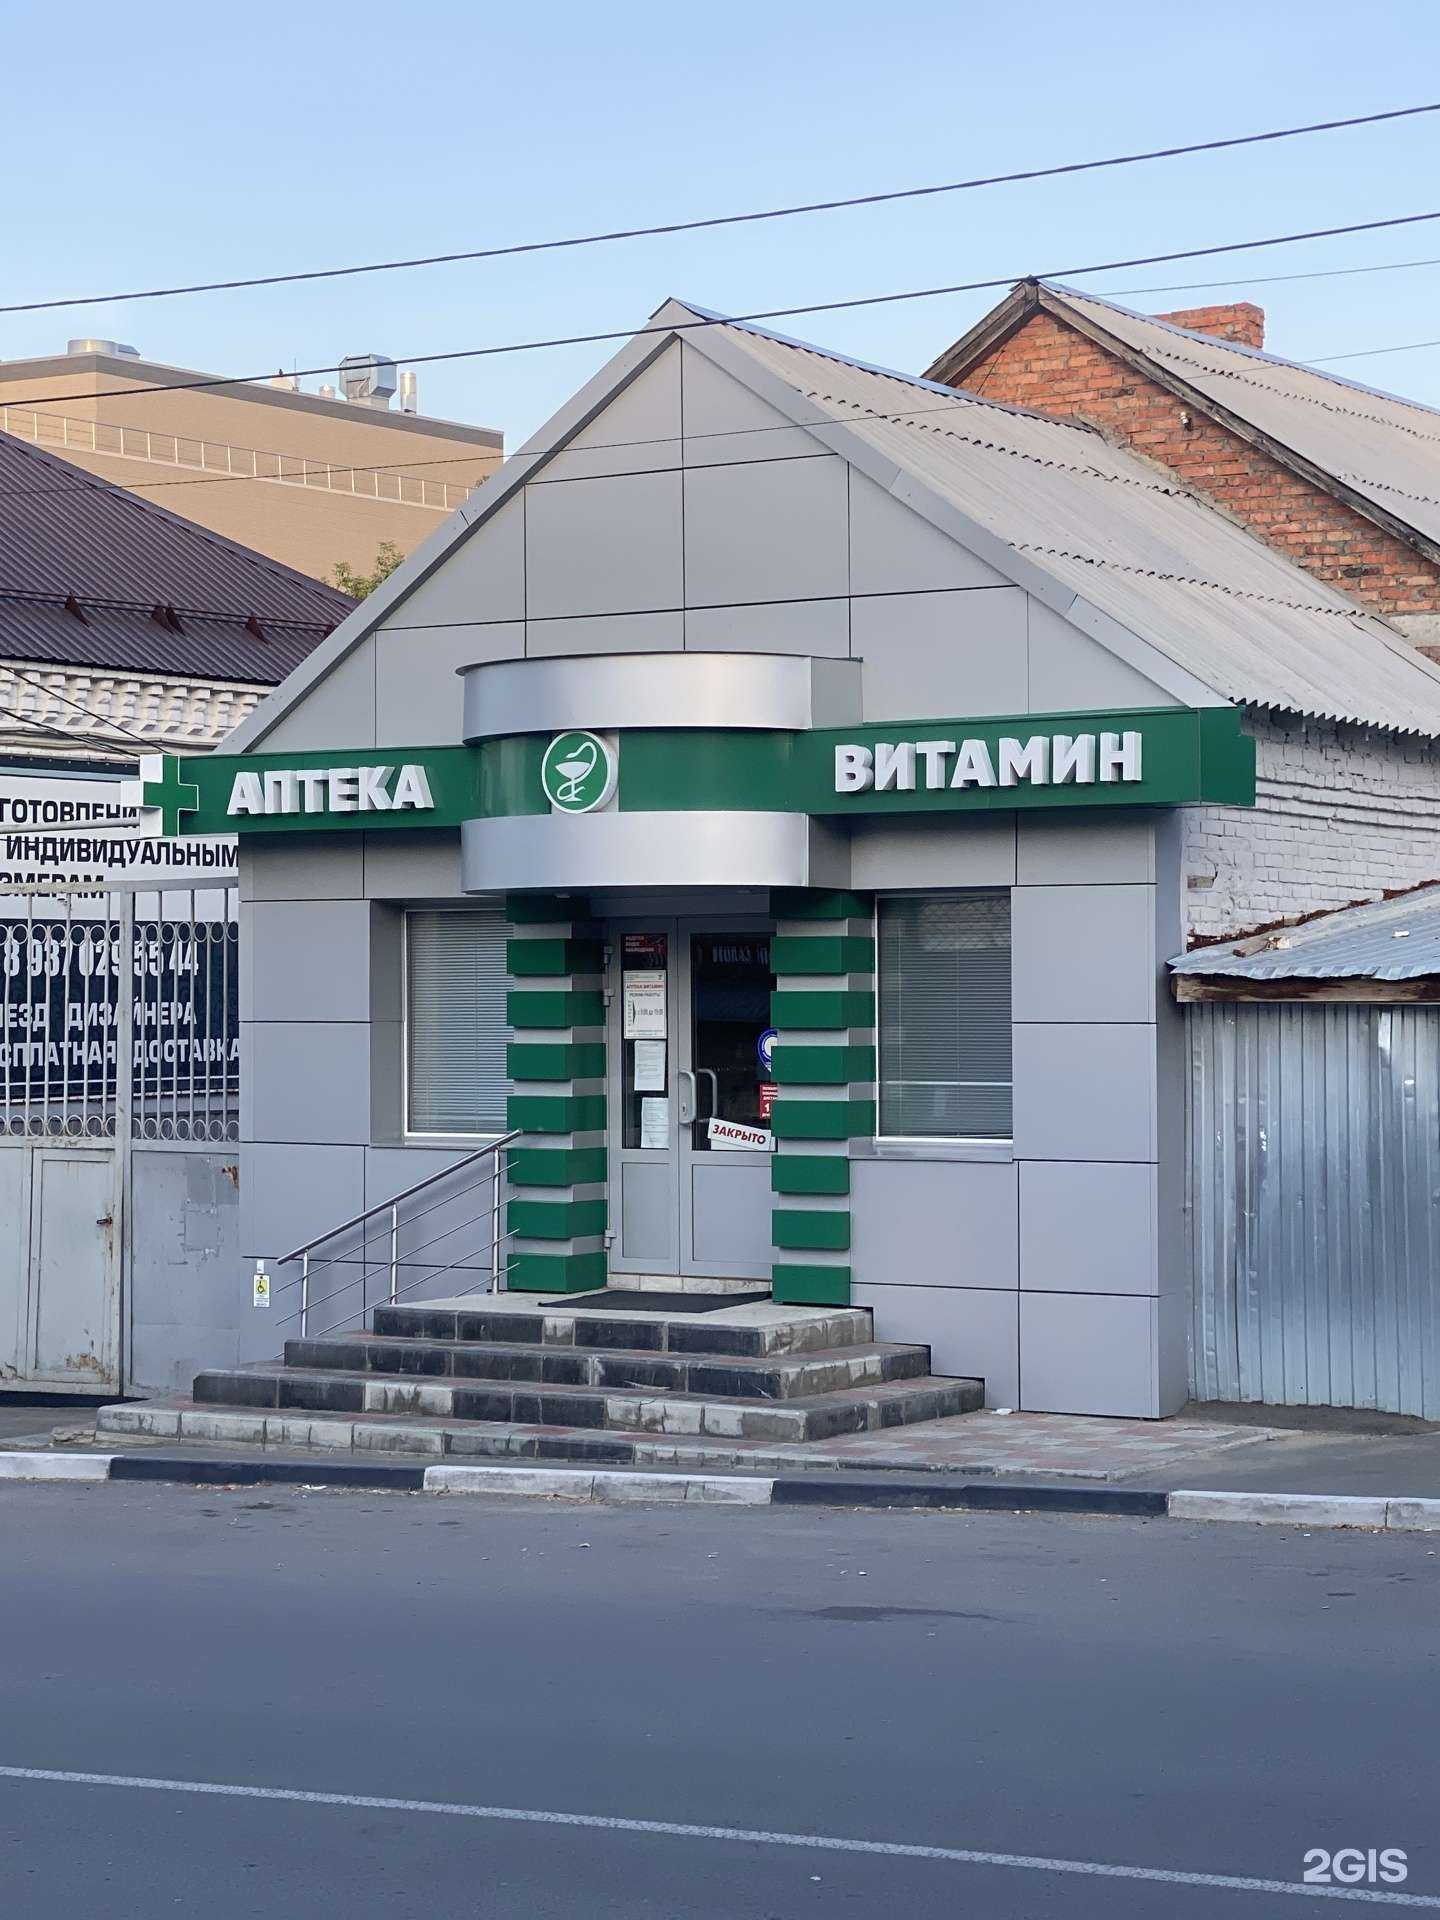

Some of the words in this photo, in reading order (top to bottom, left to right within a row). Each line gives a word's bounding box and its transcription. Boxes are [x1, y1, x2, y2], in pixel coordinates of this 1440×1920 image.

[835, 731, 1143, 793] ВИТАМИН
[227, 764, 435, 816] АПТЕКА
[6, 835, 239, 868] ИНДИВИДУАЛЬНЫМ
[0, 1002, 50, 1032] ЕЗД
[133, 1038, 240, 1068] ДОСТАВКА
[712, 1124, 766, 1145] ЗАКРЫТО
